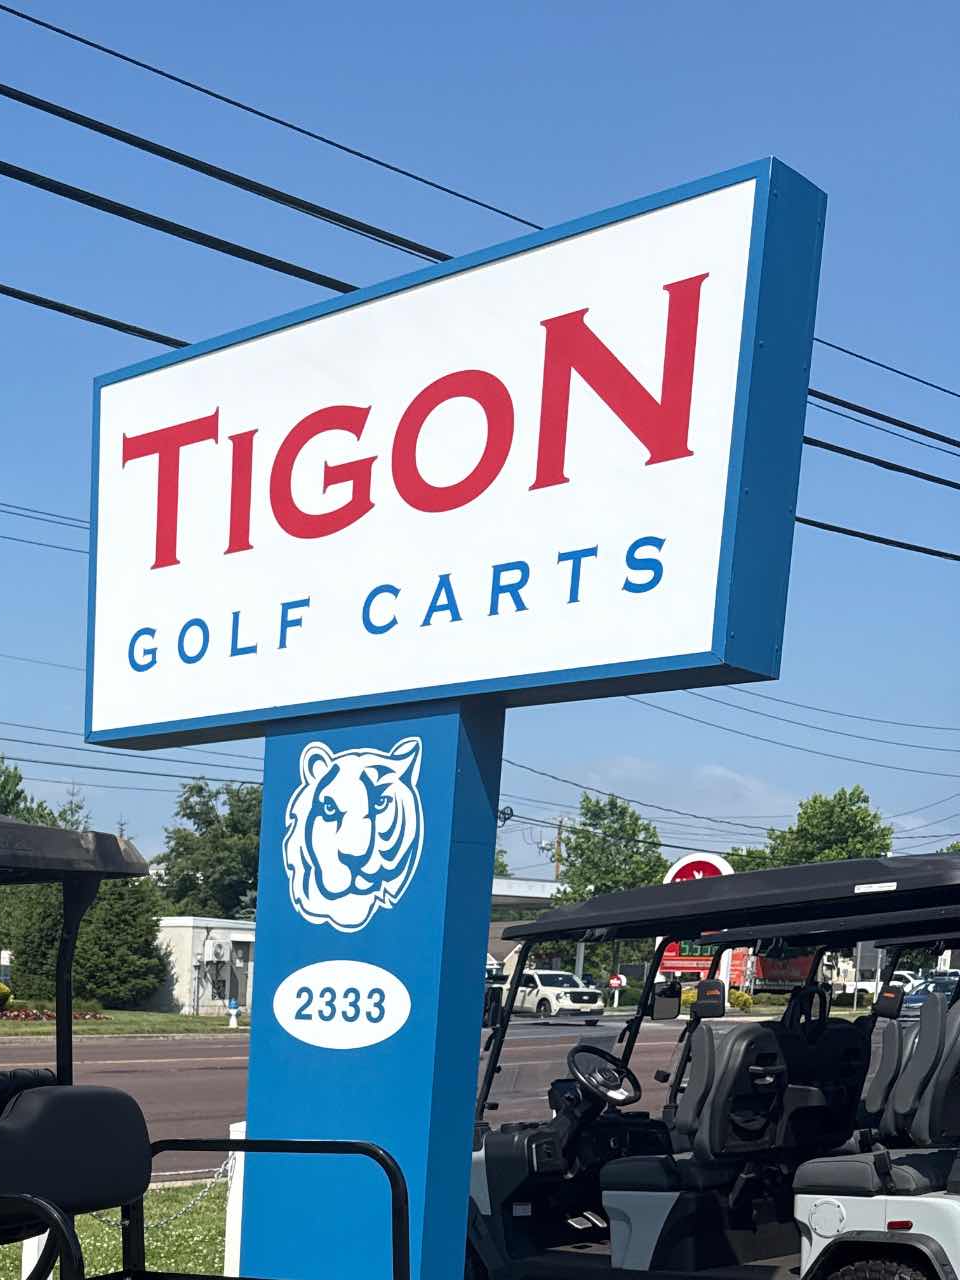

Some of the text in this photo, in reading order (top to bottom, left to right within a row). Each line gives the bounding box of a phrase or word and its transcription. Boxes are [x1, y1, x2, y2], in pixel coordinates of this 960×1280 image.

[121, 272, 710, 570] TIGON
[127, 535, 667, 673] GOLF CARTS
[294, 986, 386, 1023] 2333
